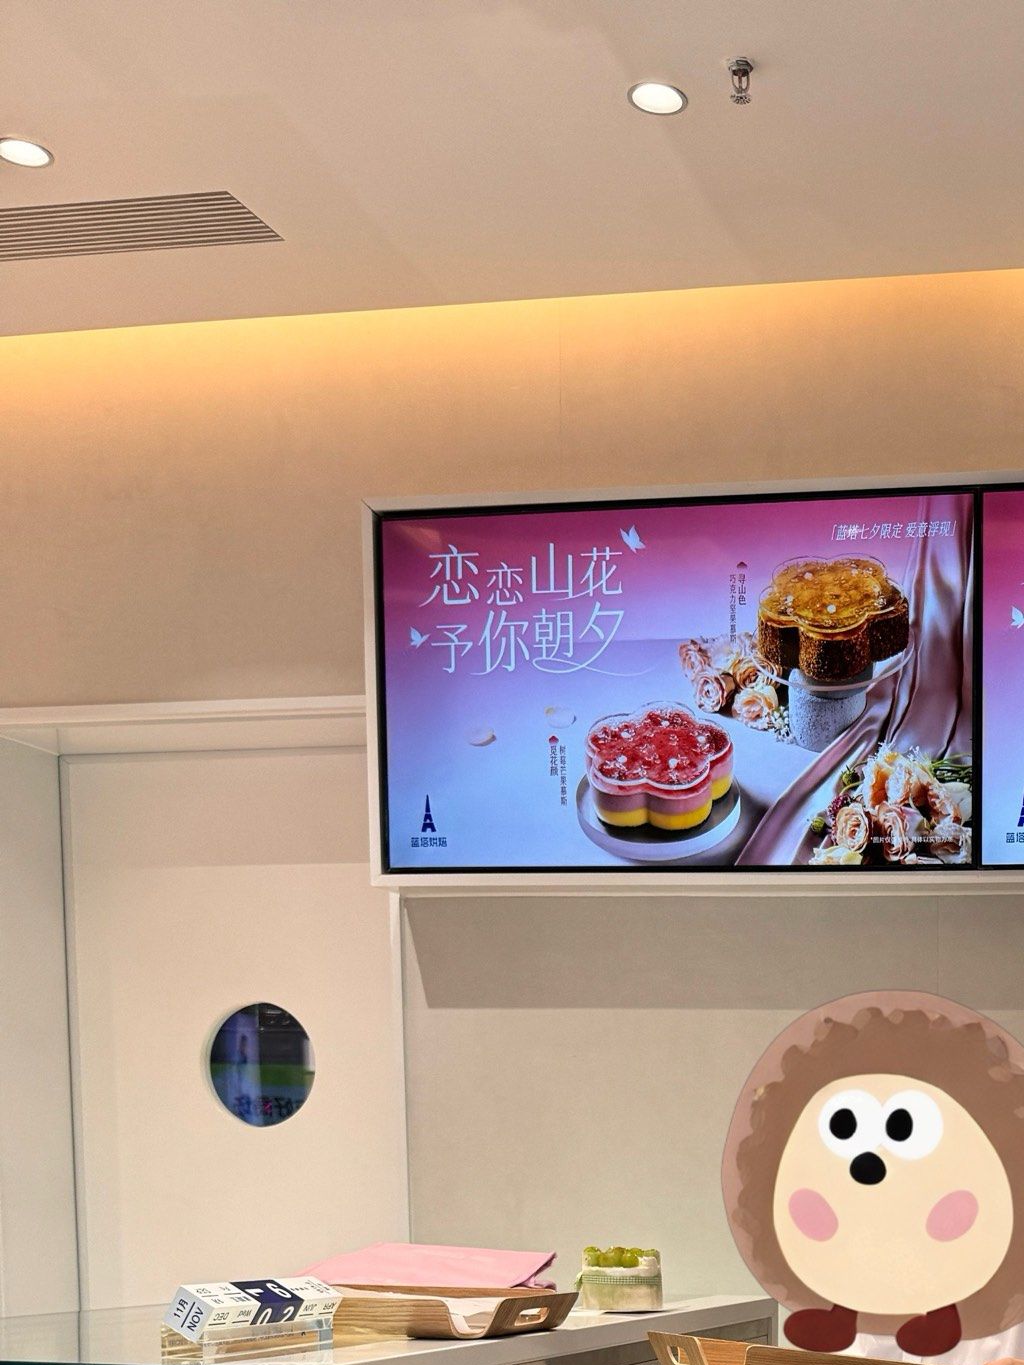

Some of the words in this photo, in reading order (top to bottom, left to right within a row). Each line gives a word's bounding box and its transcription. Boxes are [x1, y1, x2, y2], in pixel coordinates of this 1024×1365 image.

[420, 541, 624, 608] 恋恋山花
[430, 606, 630, 676] 予你朝夕
[186, 1306, 205, 1333] NOV
